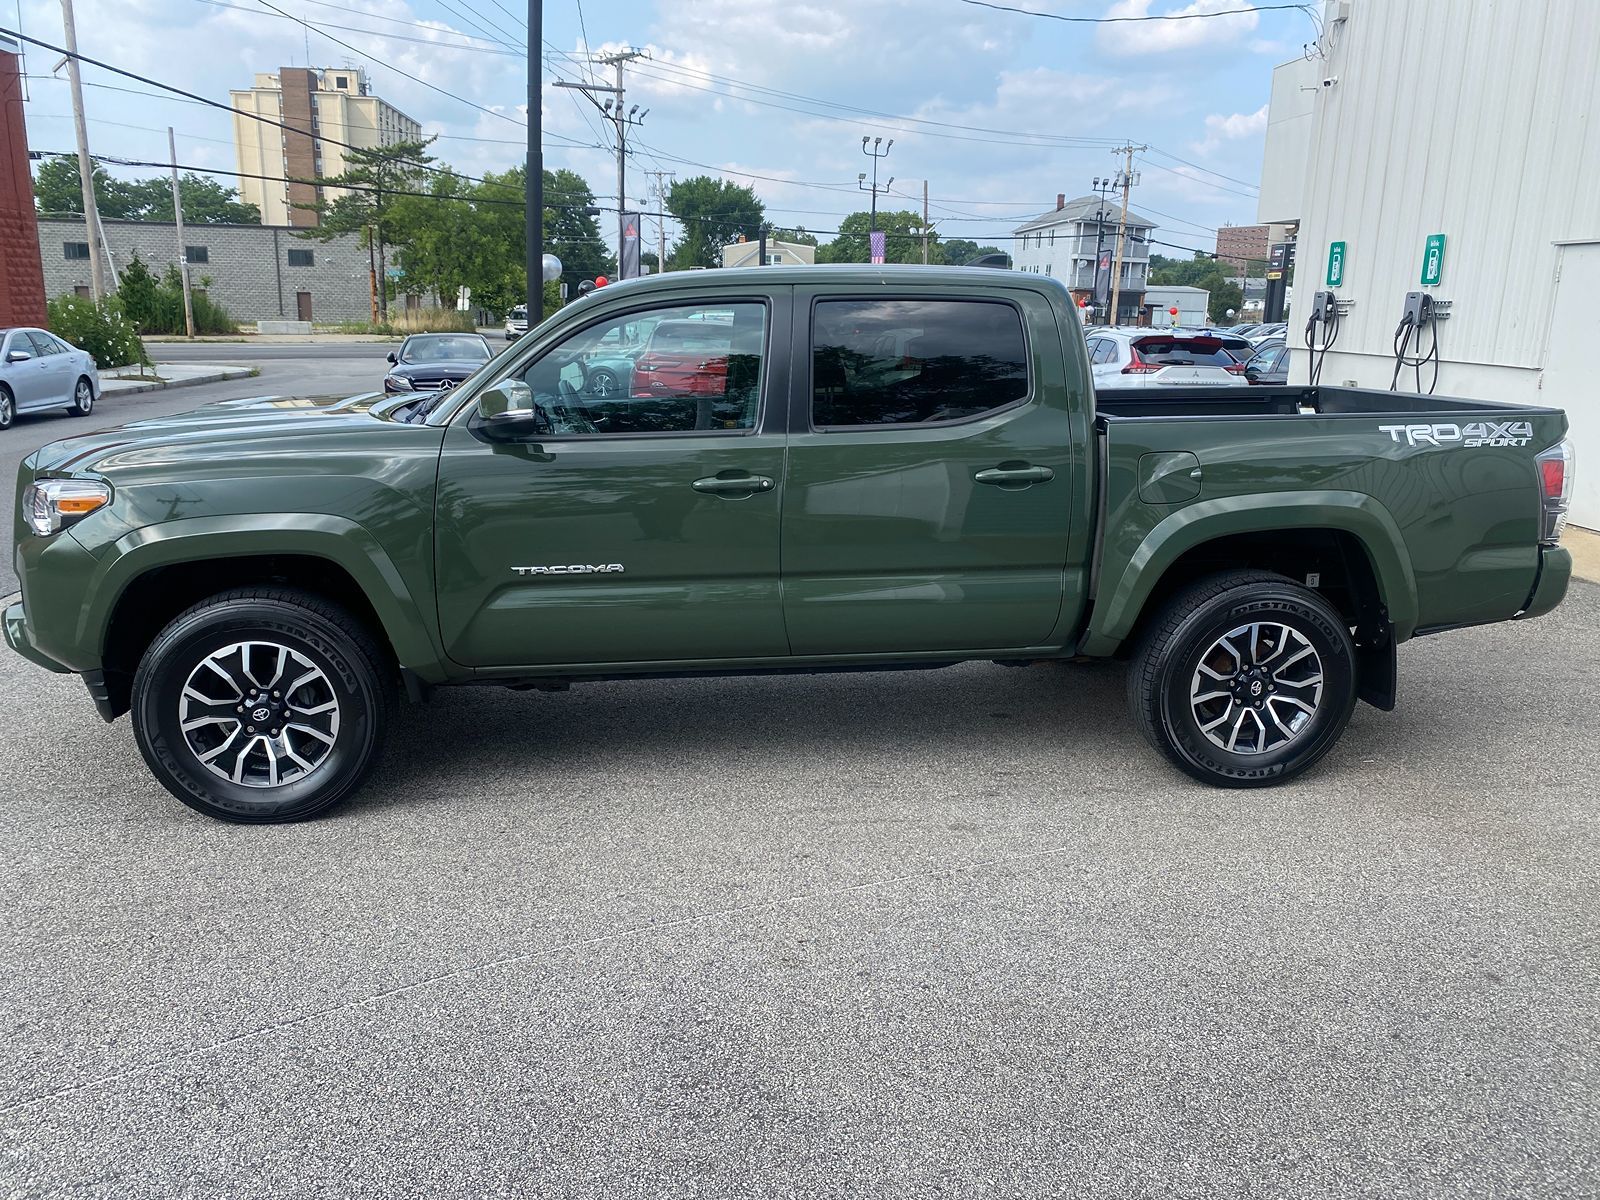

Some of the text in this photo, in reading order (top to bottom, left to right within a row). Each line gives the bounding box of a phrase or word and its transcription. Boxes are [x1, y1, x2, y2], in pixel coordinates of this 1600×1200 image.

[1379, 423, 1461, 447] TRD
[1464, 438, 1532, 447] SPORT
[510, 563, 625, 575] TACOMA
[1234, 601, 1340, 647] DESTINATION
